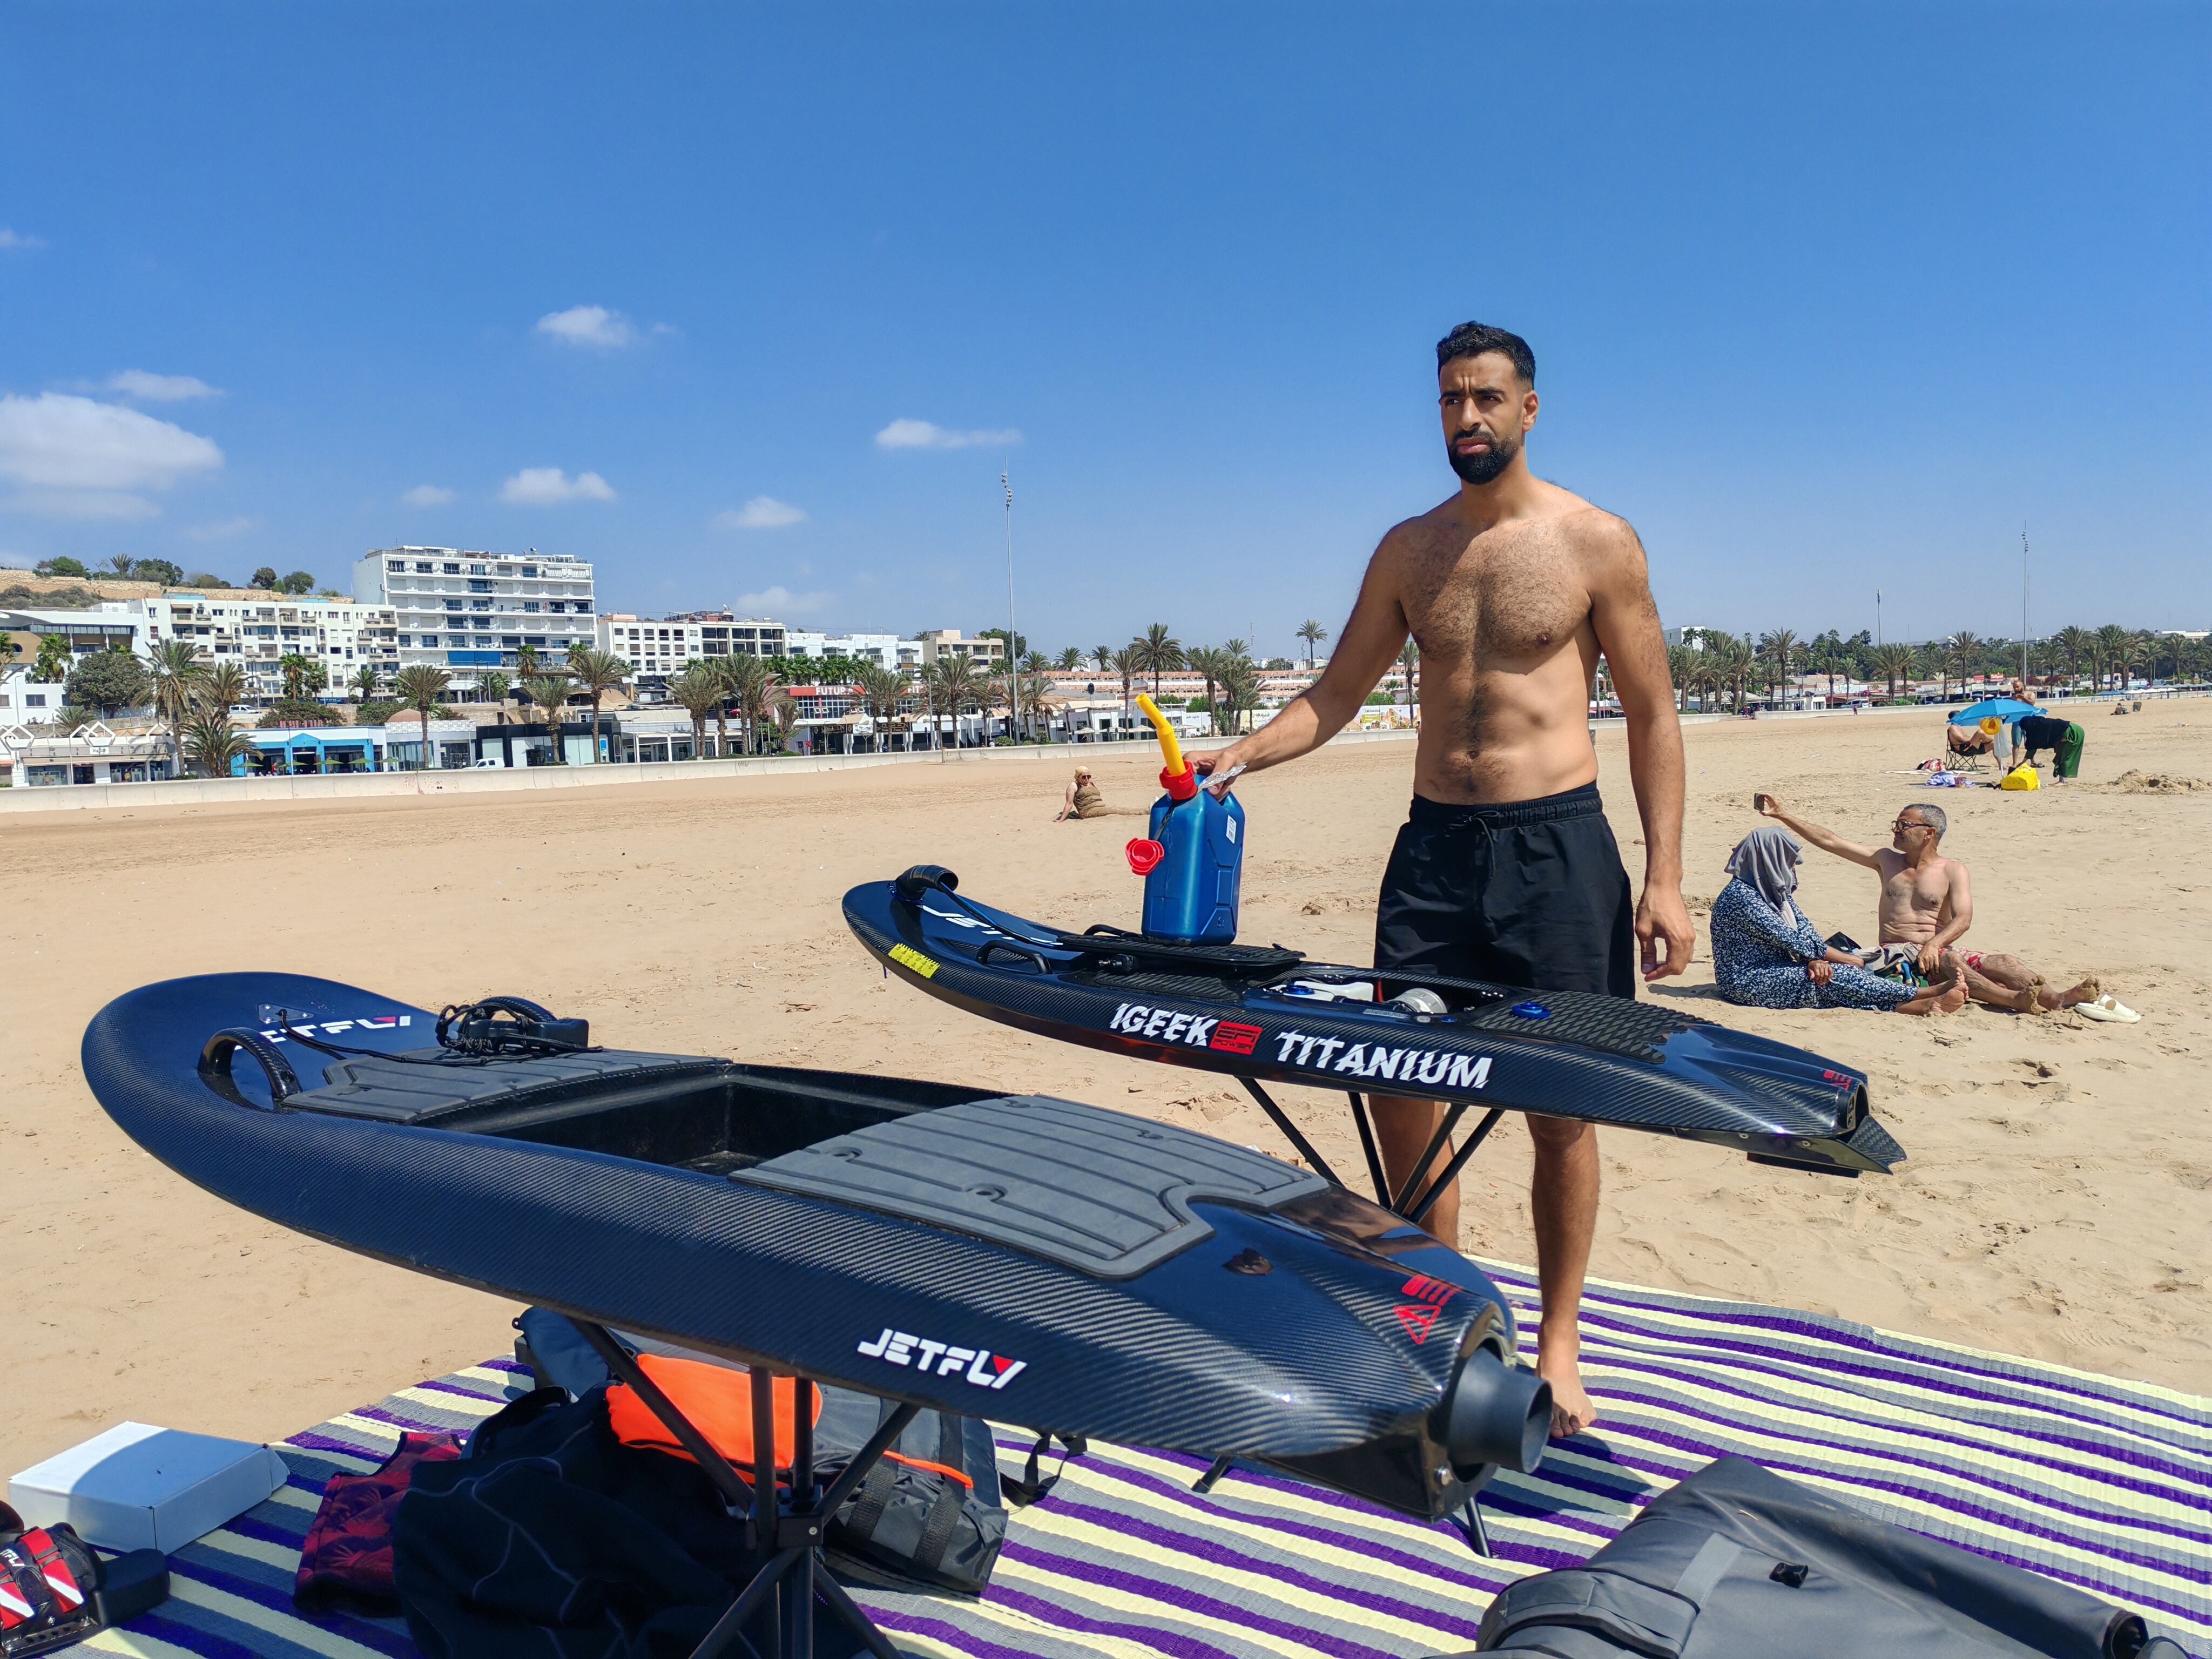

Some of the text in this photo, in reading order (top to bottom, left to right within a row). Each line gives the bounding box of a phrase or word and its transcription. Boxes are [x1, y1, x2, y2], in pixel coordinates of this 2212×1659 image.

[234, 1015, 411, 1050] ETFLY
[1109, 1002, 1219, 1047] IGEEK
[1273, 1029, 1493, 1089] TITANIUM
[857, 1328, 1028, 1390] JETFLY
